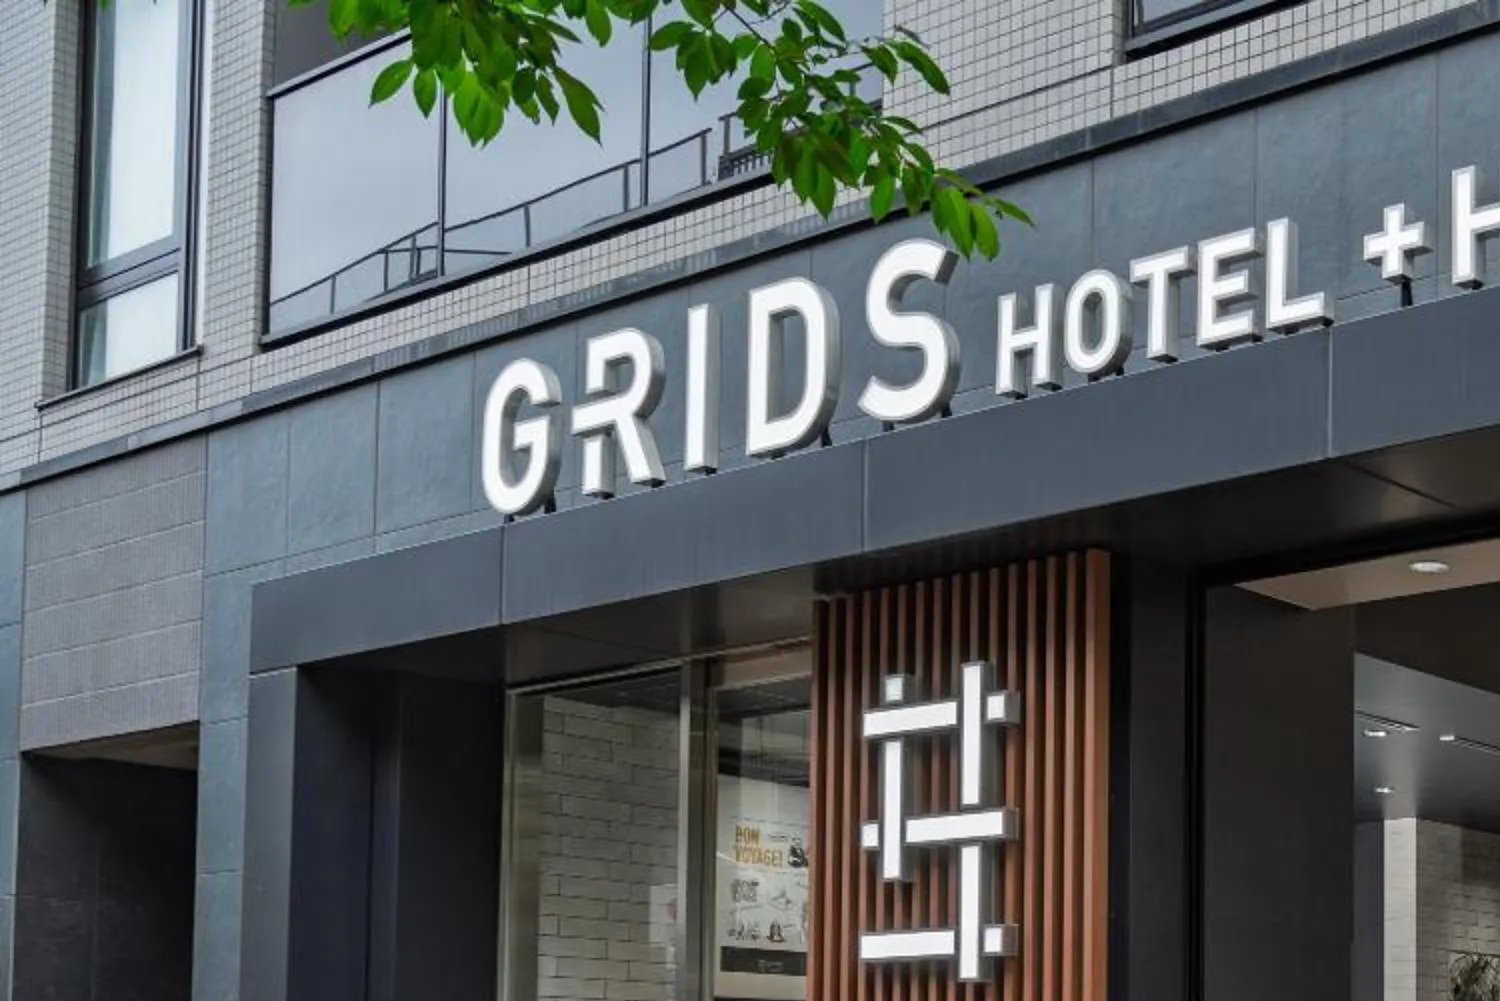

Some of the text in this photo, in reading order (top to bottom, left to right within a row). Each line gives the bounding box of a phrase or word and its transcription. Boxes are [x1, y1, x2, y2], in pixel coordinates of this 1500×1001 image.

[481, 238, 961, 516] GRIDS
[996, 216, 1331, 399] HOTEL
[735, 826, 761, 844] BON
[734, 846, 784, 868] VOYAGE!
